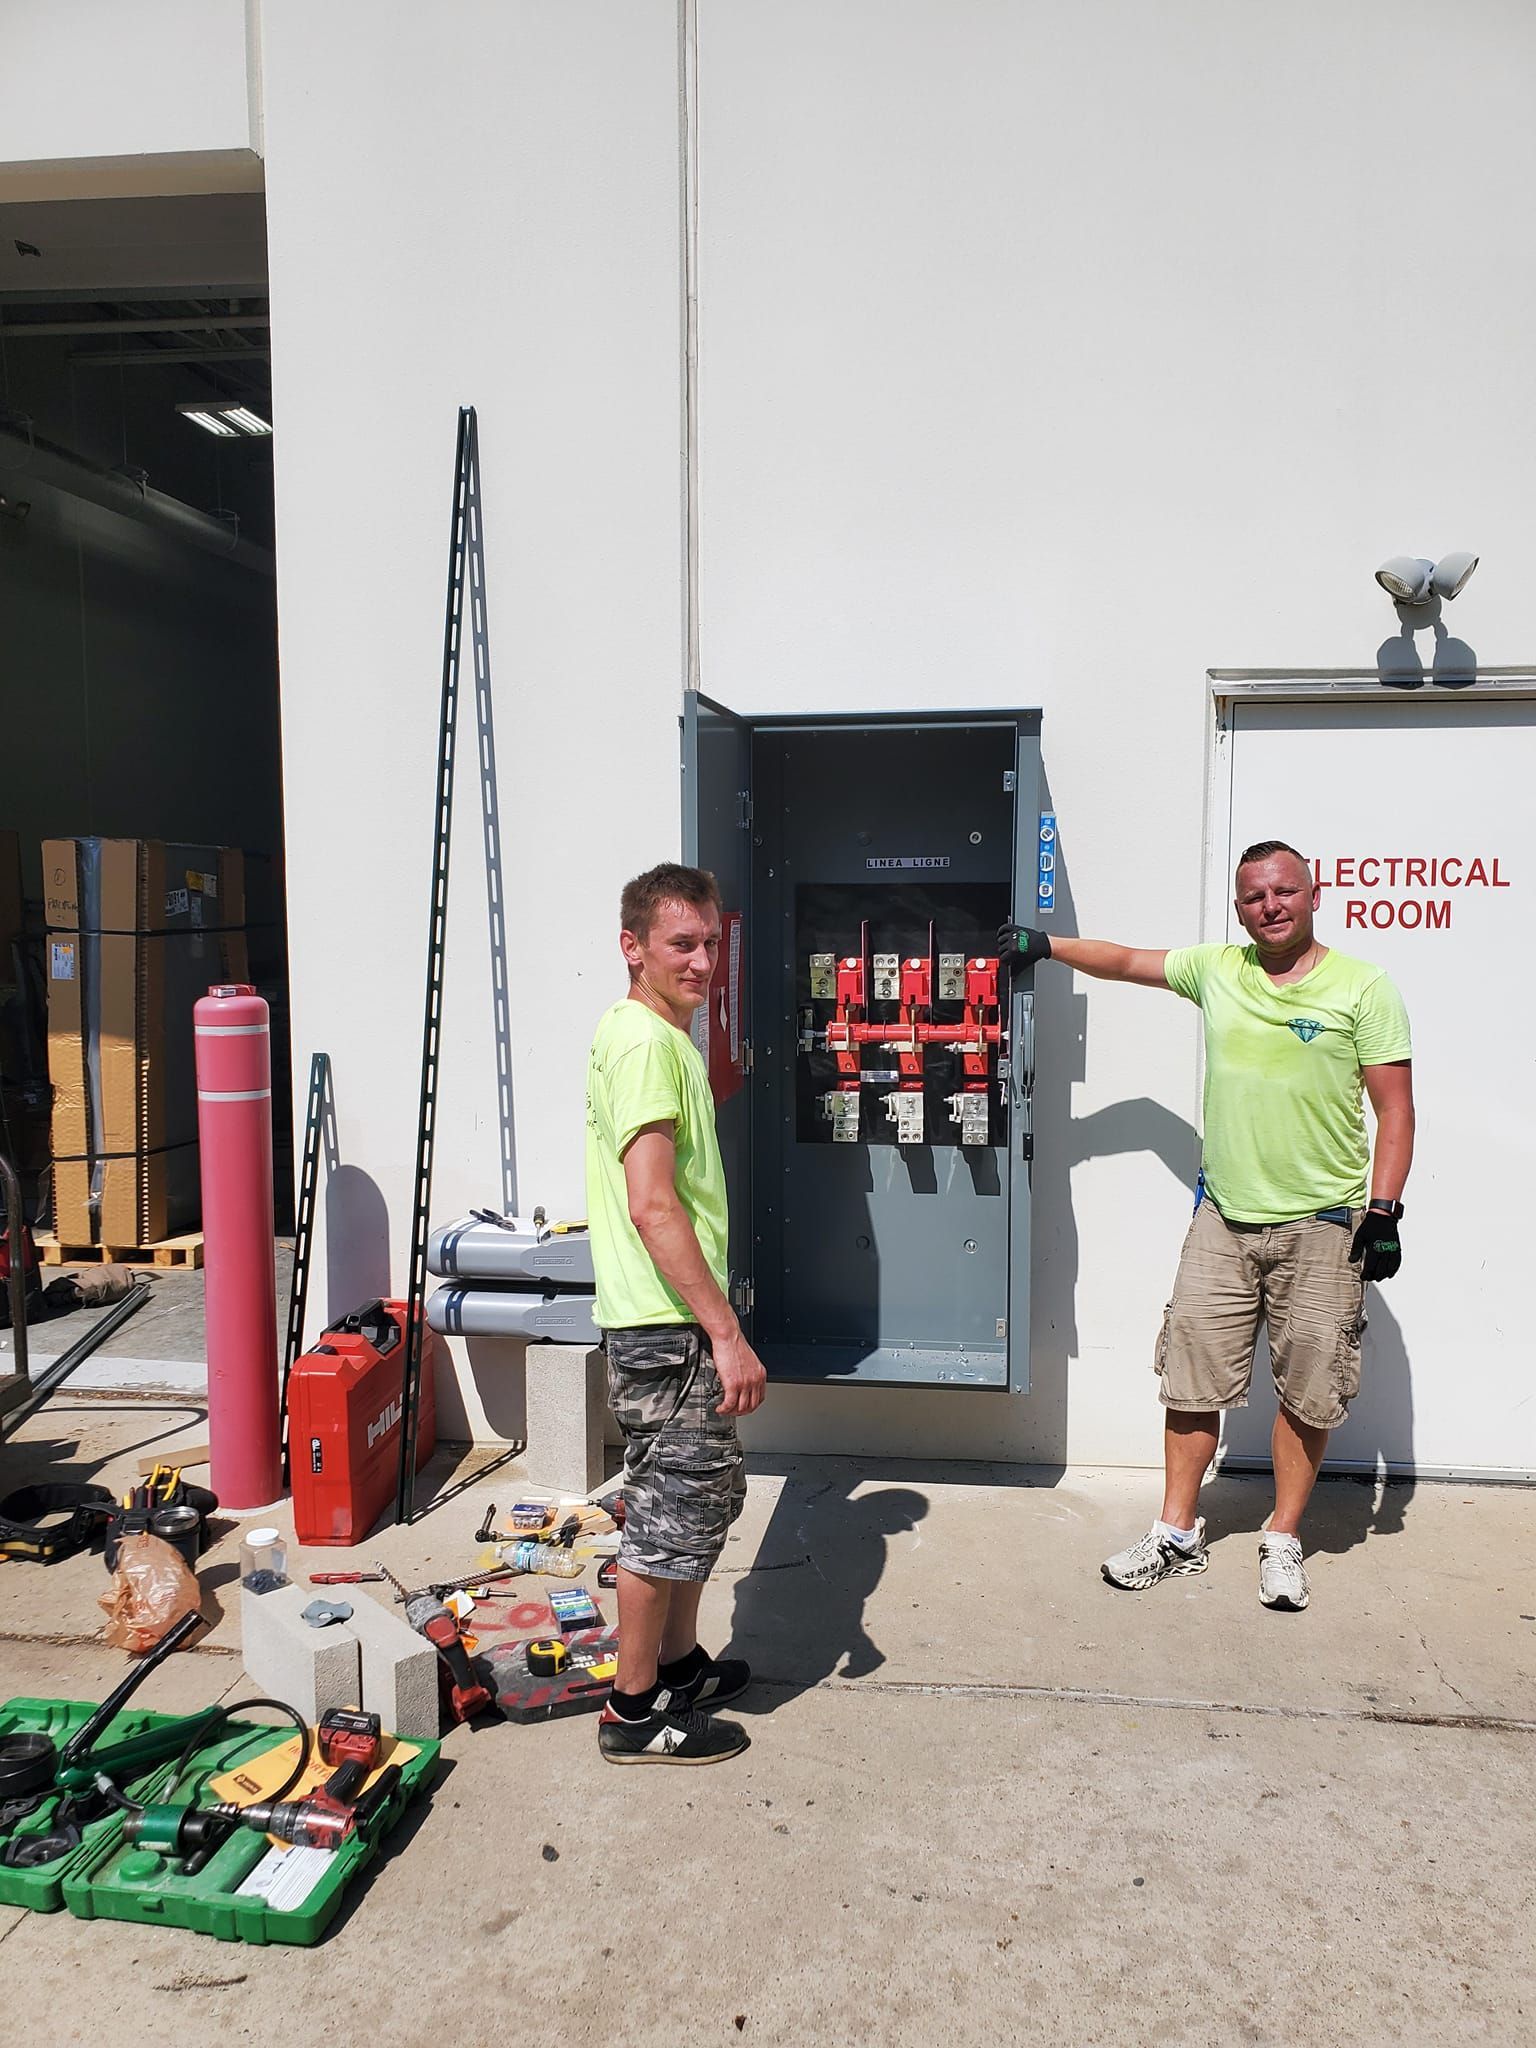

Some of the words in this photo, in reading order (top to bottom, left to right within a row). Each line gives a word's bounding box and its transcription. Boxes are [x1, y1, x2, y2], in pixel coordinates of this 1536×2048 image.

[867, 859, 902, 867] LINEA
[913, 858, 949, 867] LIGNE
[1303, 858, 1511, 887] LECTRICAL
[1346, 900, 1452, 929] ROOM
[367, 1380, 420, 1449] HIL
[1137, 1566, 1149, 1578] SO
